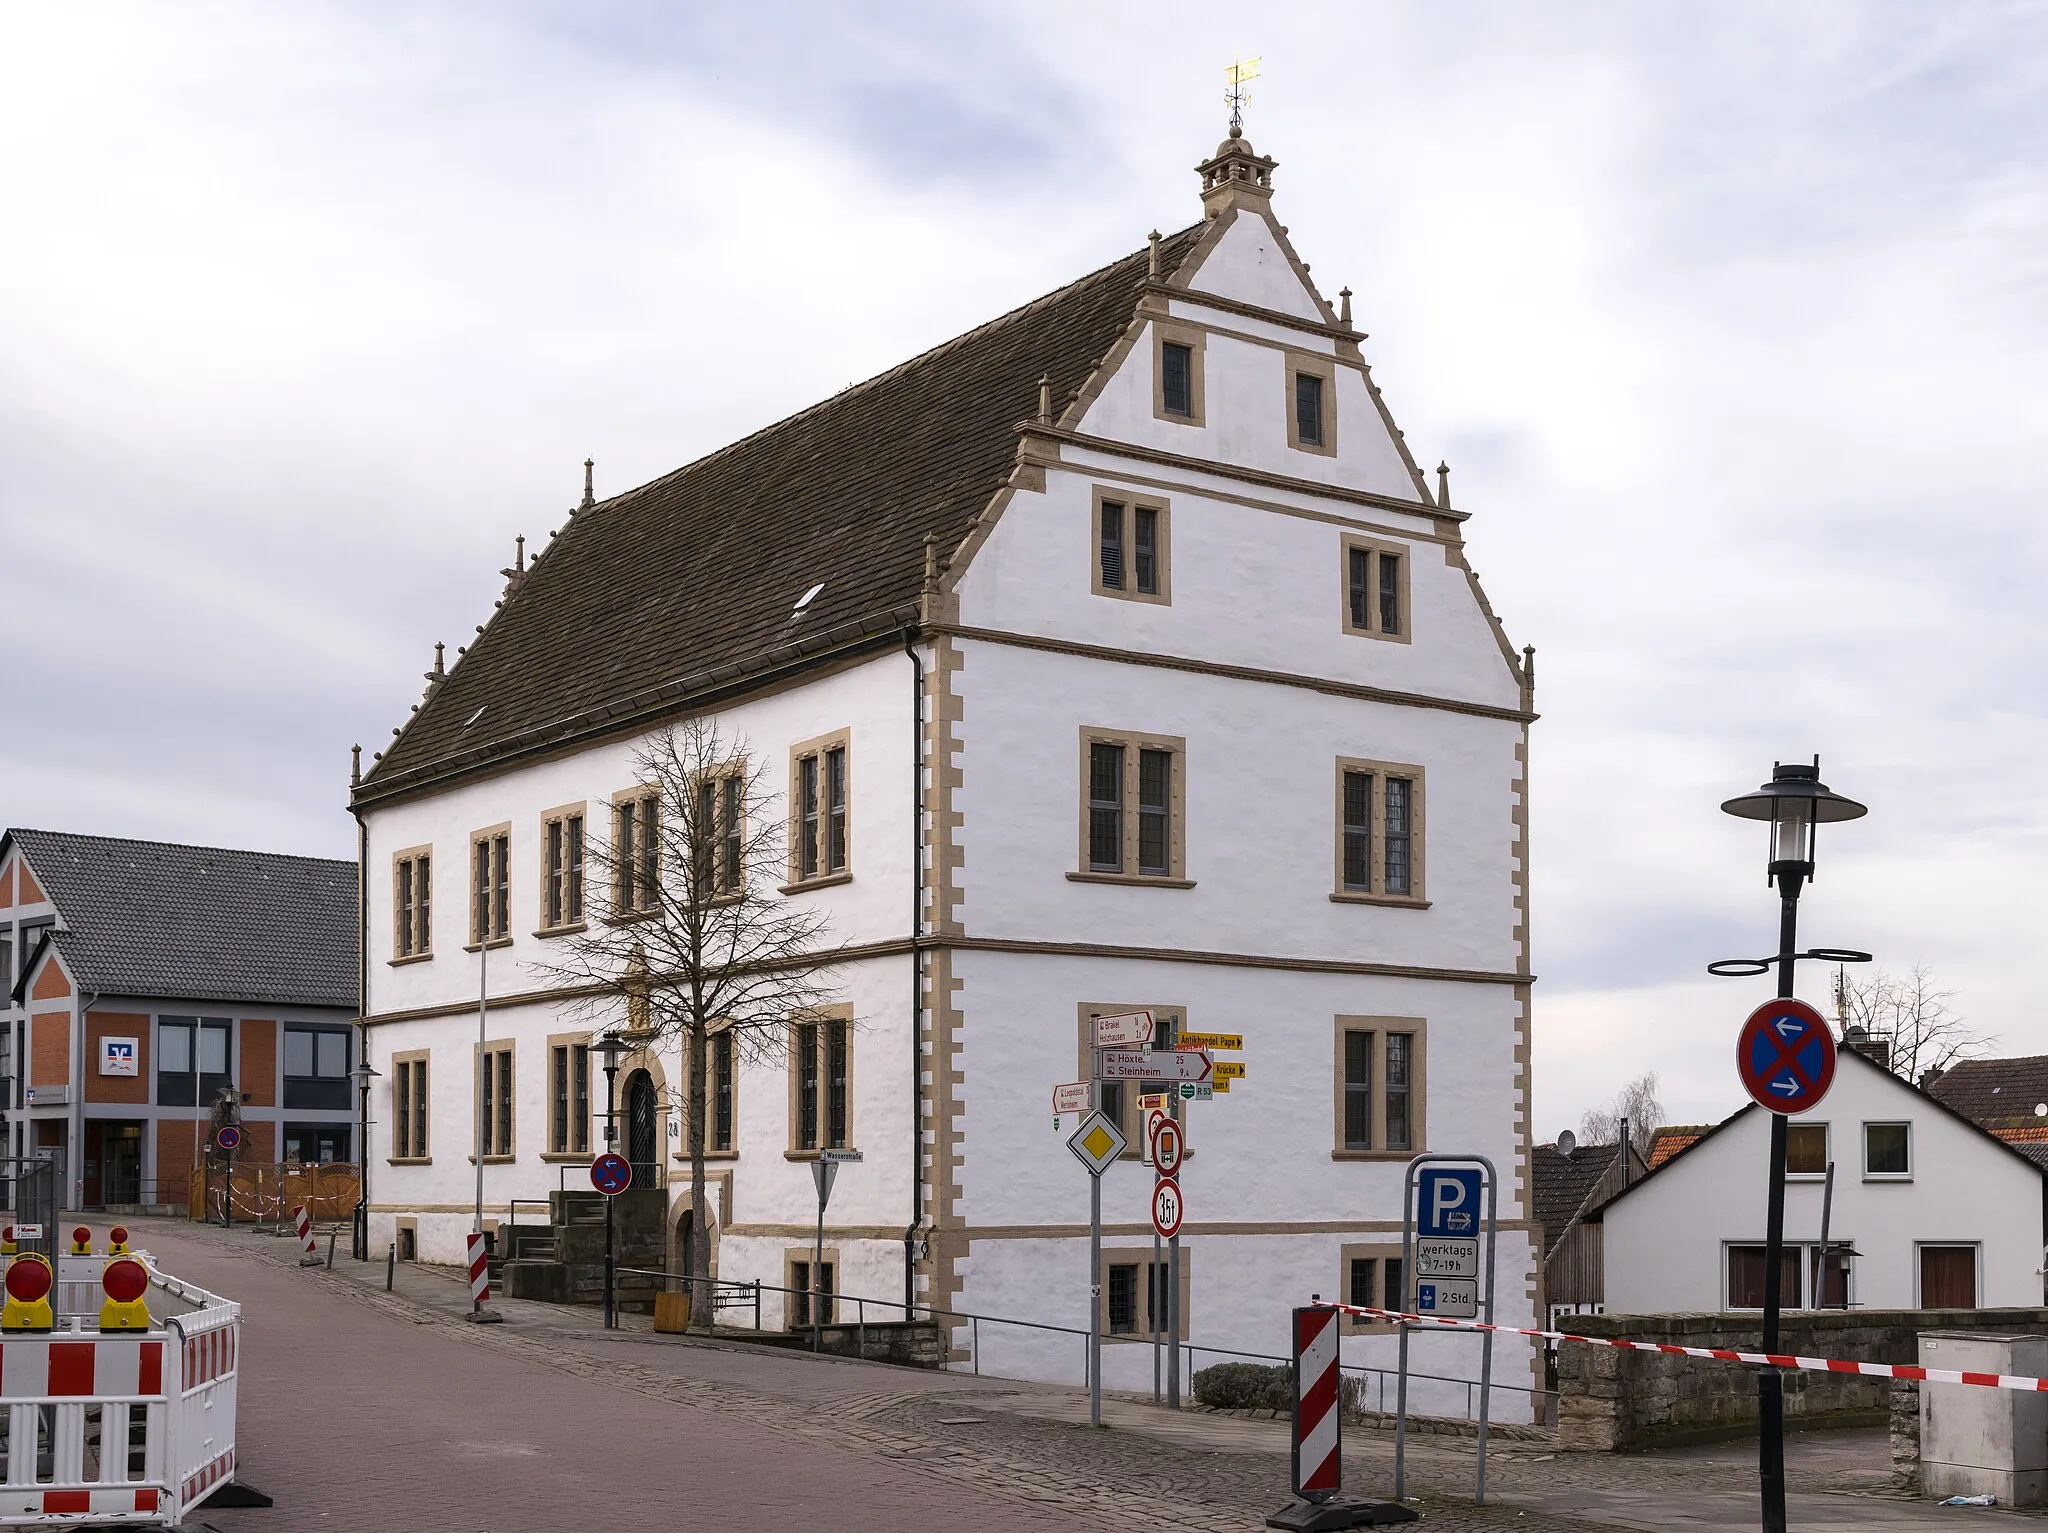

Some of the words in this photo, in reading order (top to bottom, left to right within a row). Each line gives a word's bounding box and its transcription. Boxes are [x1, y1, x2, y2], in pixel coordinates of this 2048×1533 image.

[1105, 1020, 1120, 1030] Brakel
[1100, 1033, 1126, 1042] Holzhausen
[1220, 1037, 1236, 1048] Pape
[1118, 1053, 1145, 1063] Höxte
[1175, 1056, 1184, 1065] 25
[1118, 1066, 1161, 1076] Steinheim
[1180, 1068, 1190, 1077] 9,4
[1216, 1064, 1236, 1075] Krücke
[1197, 1088, 1202, 1096] R
[1203, 1088, 1212, 1096] 53
[668, 1122, 678, 1137] 28
[826, 1152, 862, 1160] Wasserstraße
[1432, 1177, 1466, 1228] P
[1422, 1245, 1473, 1258] werktags
[1442, 1292, 1448, 1303] 2
[1450, 1293, 1471, 1304] Std.
